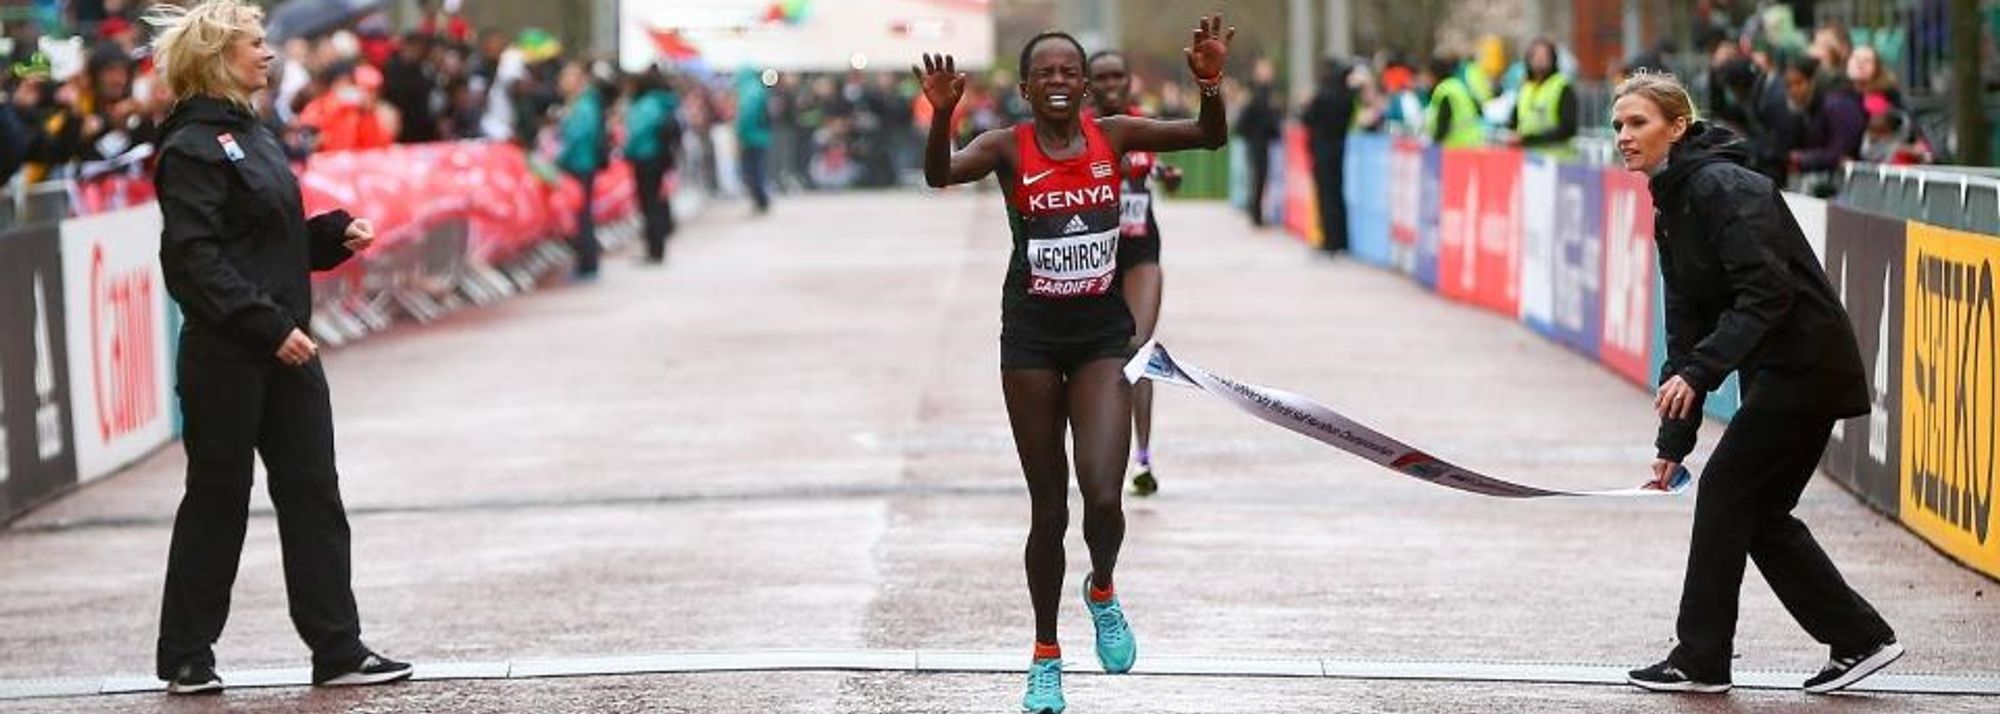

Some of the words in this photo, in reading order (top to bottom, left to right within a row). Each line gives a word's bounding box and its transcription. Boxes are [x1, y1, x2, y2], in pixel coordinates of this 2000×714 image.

[1029, 185, 1114, 211] KENYA
[1033, 278, 1097, 295] CARDIFF
[1911, 249, 1994, 546] SEIKO
